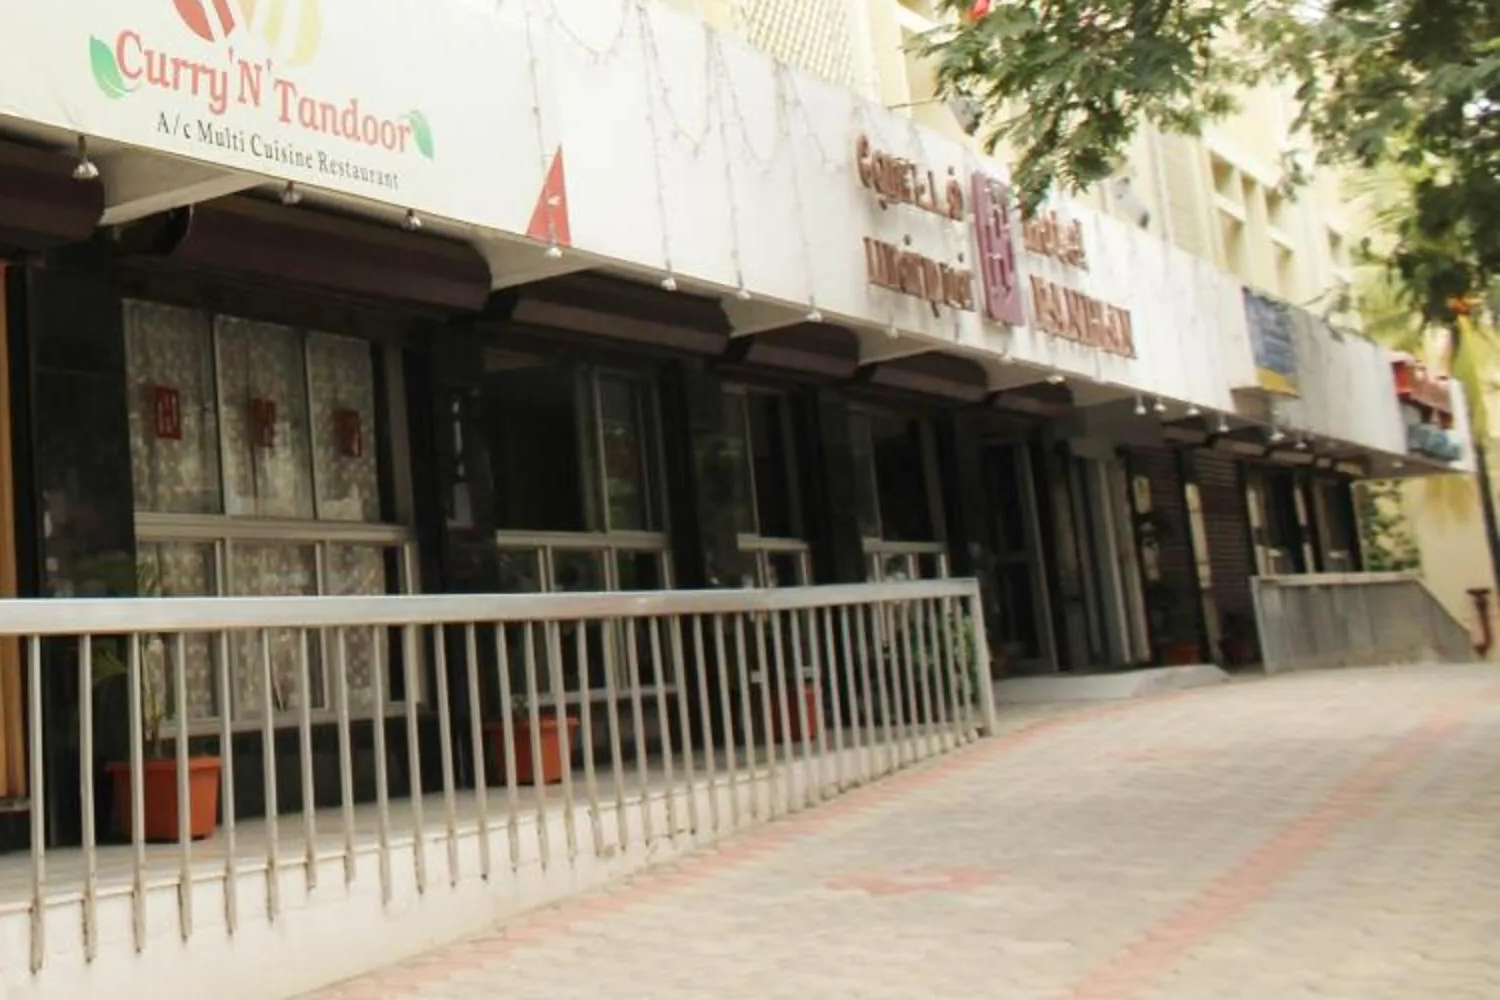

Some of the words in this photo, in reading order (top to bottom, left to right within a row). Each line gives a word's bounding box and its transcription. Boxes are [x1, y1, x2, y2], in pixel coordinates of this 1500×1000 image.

[116, 30, 229, 116] Curry
[274, 78, 412, 153] Tandoor
[197, 119, 246, 153] Multi
[251, 133, 313, 171] Cuisine
[318, 151, 400, 191] Restaurant
